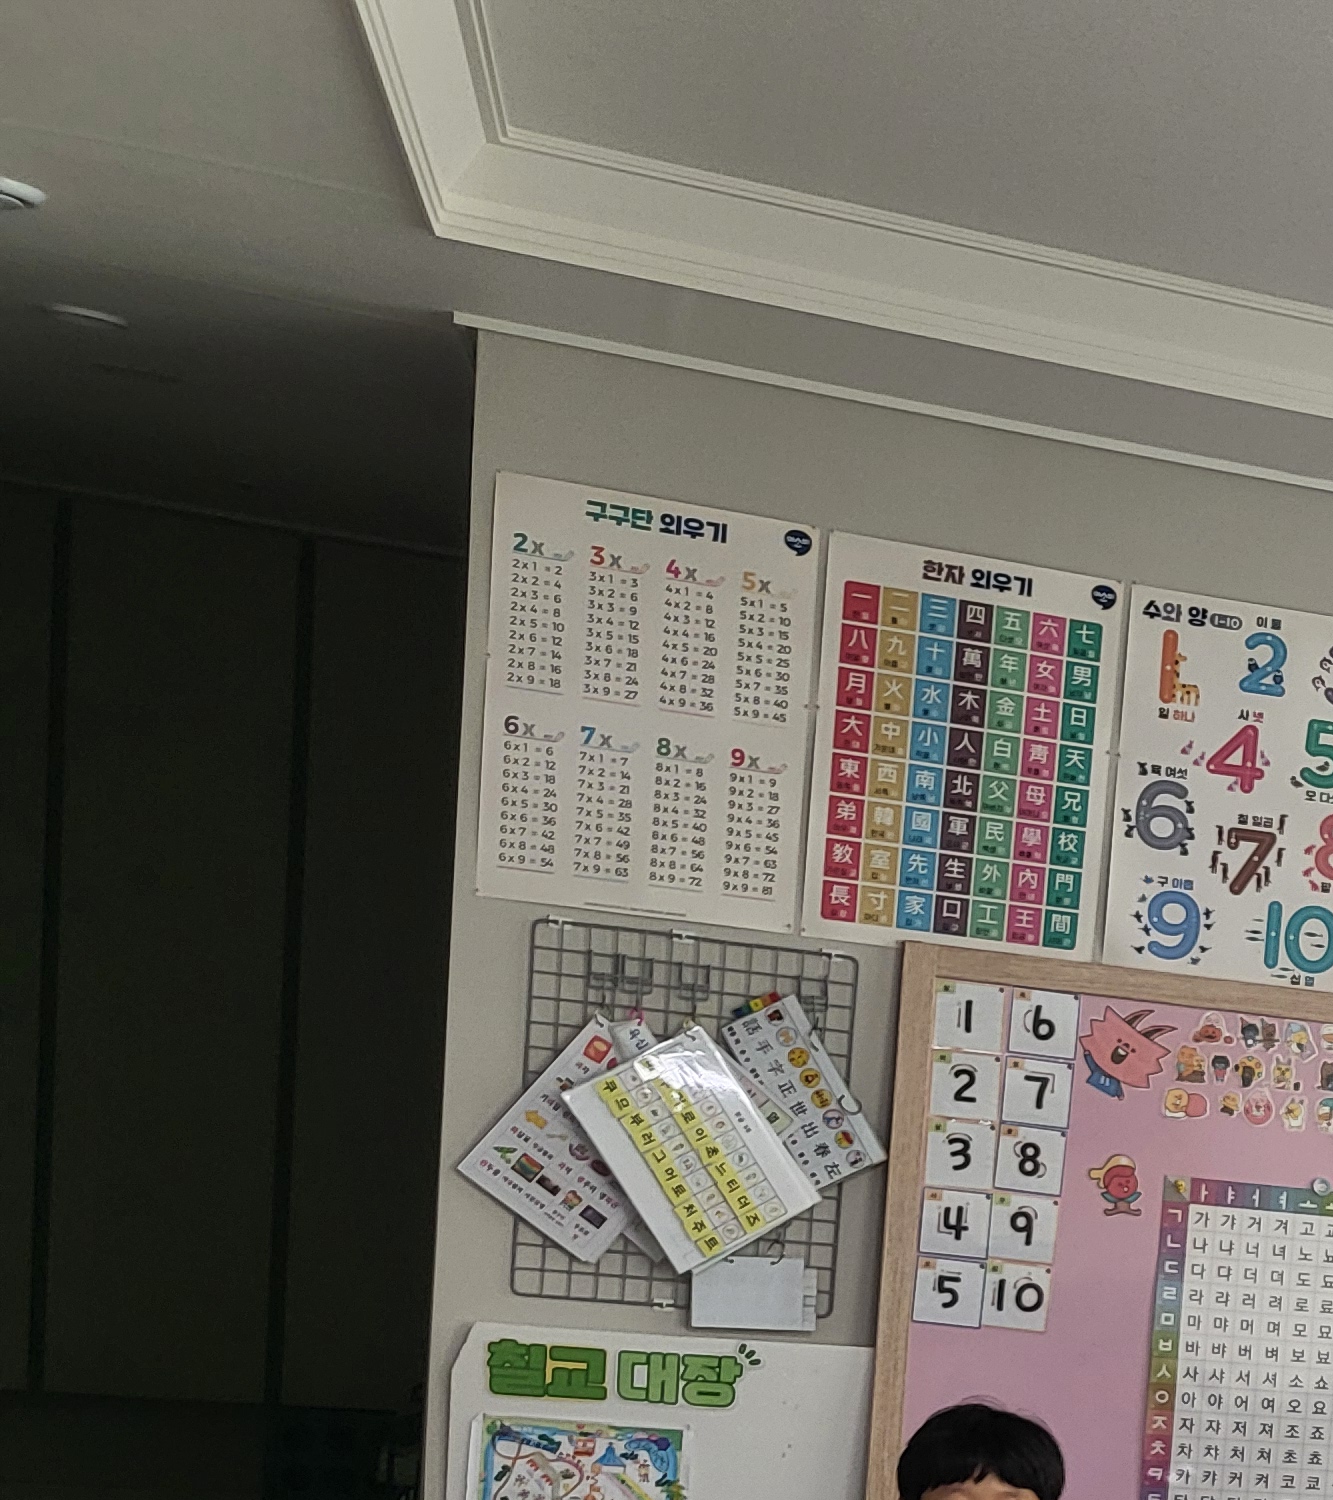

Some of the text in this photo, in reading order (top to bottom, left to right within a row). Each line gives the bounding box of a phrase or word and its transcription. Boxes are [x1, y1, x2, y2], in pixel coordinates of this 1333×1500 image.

[585, 499, 728, 544] 구구단 외우기
[922, 560, 1033, 598] 한자 외우기
[1142, 600, 1182, 623] 수와
[1187, 606, 1208, 627] 양
[850, 630, 868, 649] 八
[888, 636, 906, 655] 九
[925, 643, 945, 661] 十
[1000, 655, 1019, 672] 年
[1036, 661, 1054, 680] 女
[1073, 666, 1091, 686] 男
[1239, 631, 1288, 698] 2
[1206, 724, 1265, 795] 4
[1135, 780, 1189, 850] 6
[1226, 827, 1278, 896] 7
[1147, 890, 1200, 961] 9
[964, 999, 974, 1034] 1
[1032, 1004, 1056, 1041] 6
[953, 1068, 978, 1103] 2
[1023, 1075, 1051, 1110] 7
[947, 1137, 972, 1171] 3
[1018, 1142, 1042, 1177] 8
[943, 1205, 970, 1241] 4
[1010, 1210, 1034, 1247] 9
[1193, 1212, 1210, 1228] 가
[1220, 1215, 1236, 1230] 갸
[1248, 1217, 1262, 1232] 거
[1274, 1219, 1288, 1234] 겨
[1300, 1223, 1315, 1235] 고
[937, 1274, 963, 1309] 5
[996, 1278, 1045, 1313] 10
[616, 1349, 744, 1408] 대장
